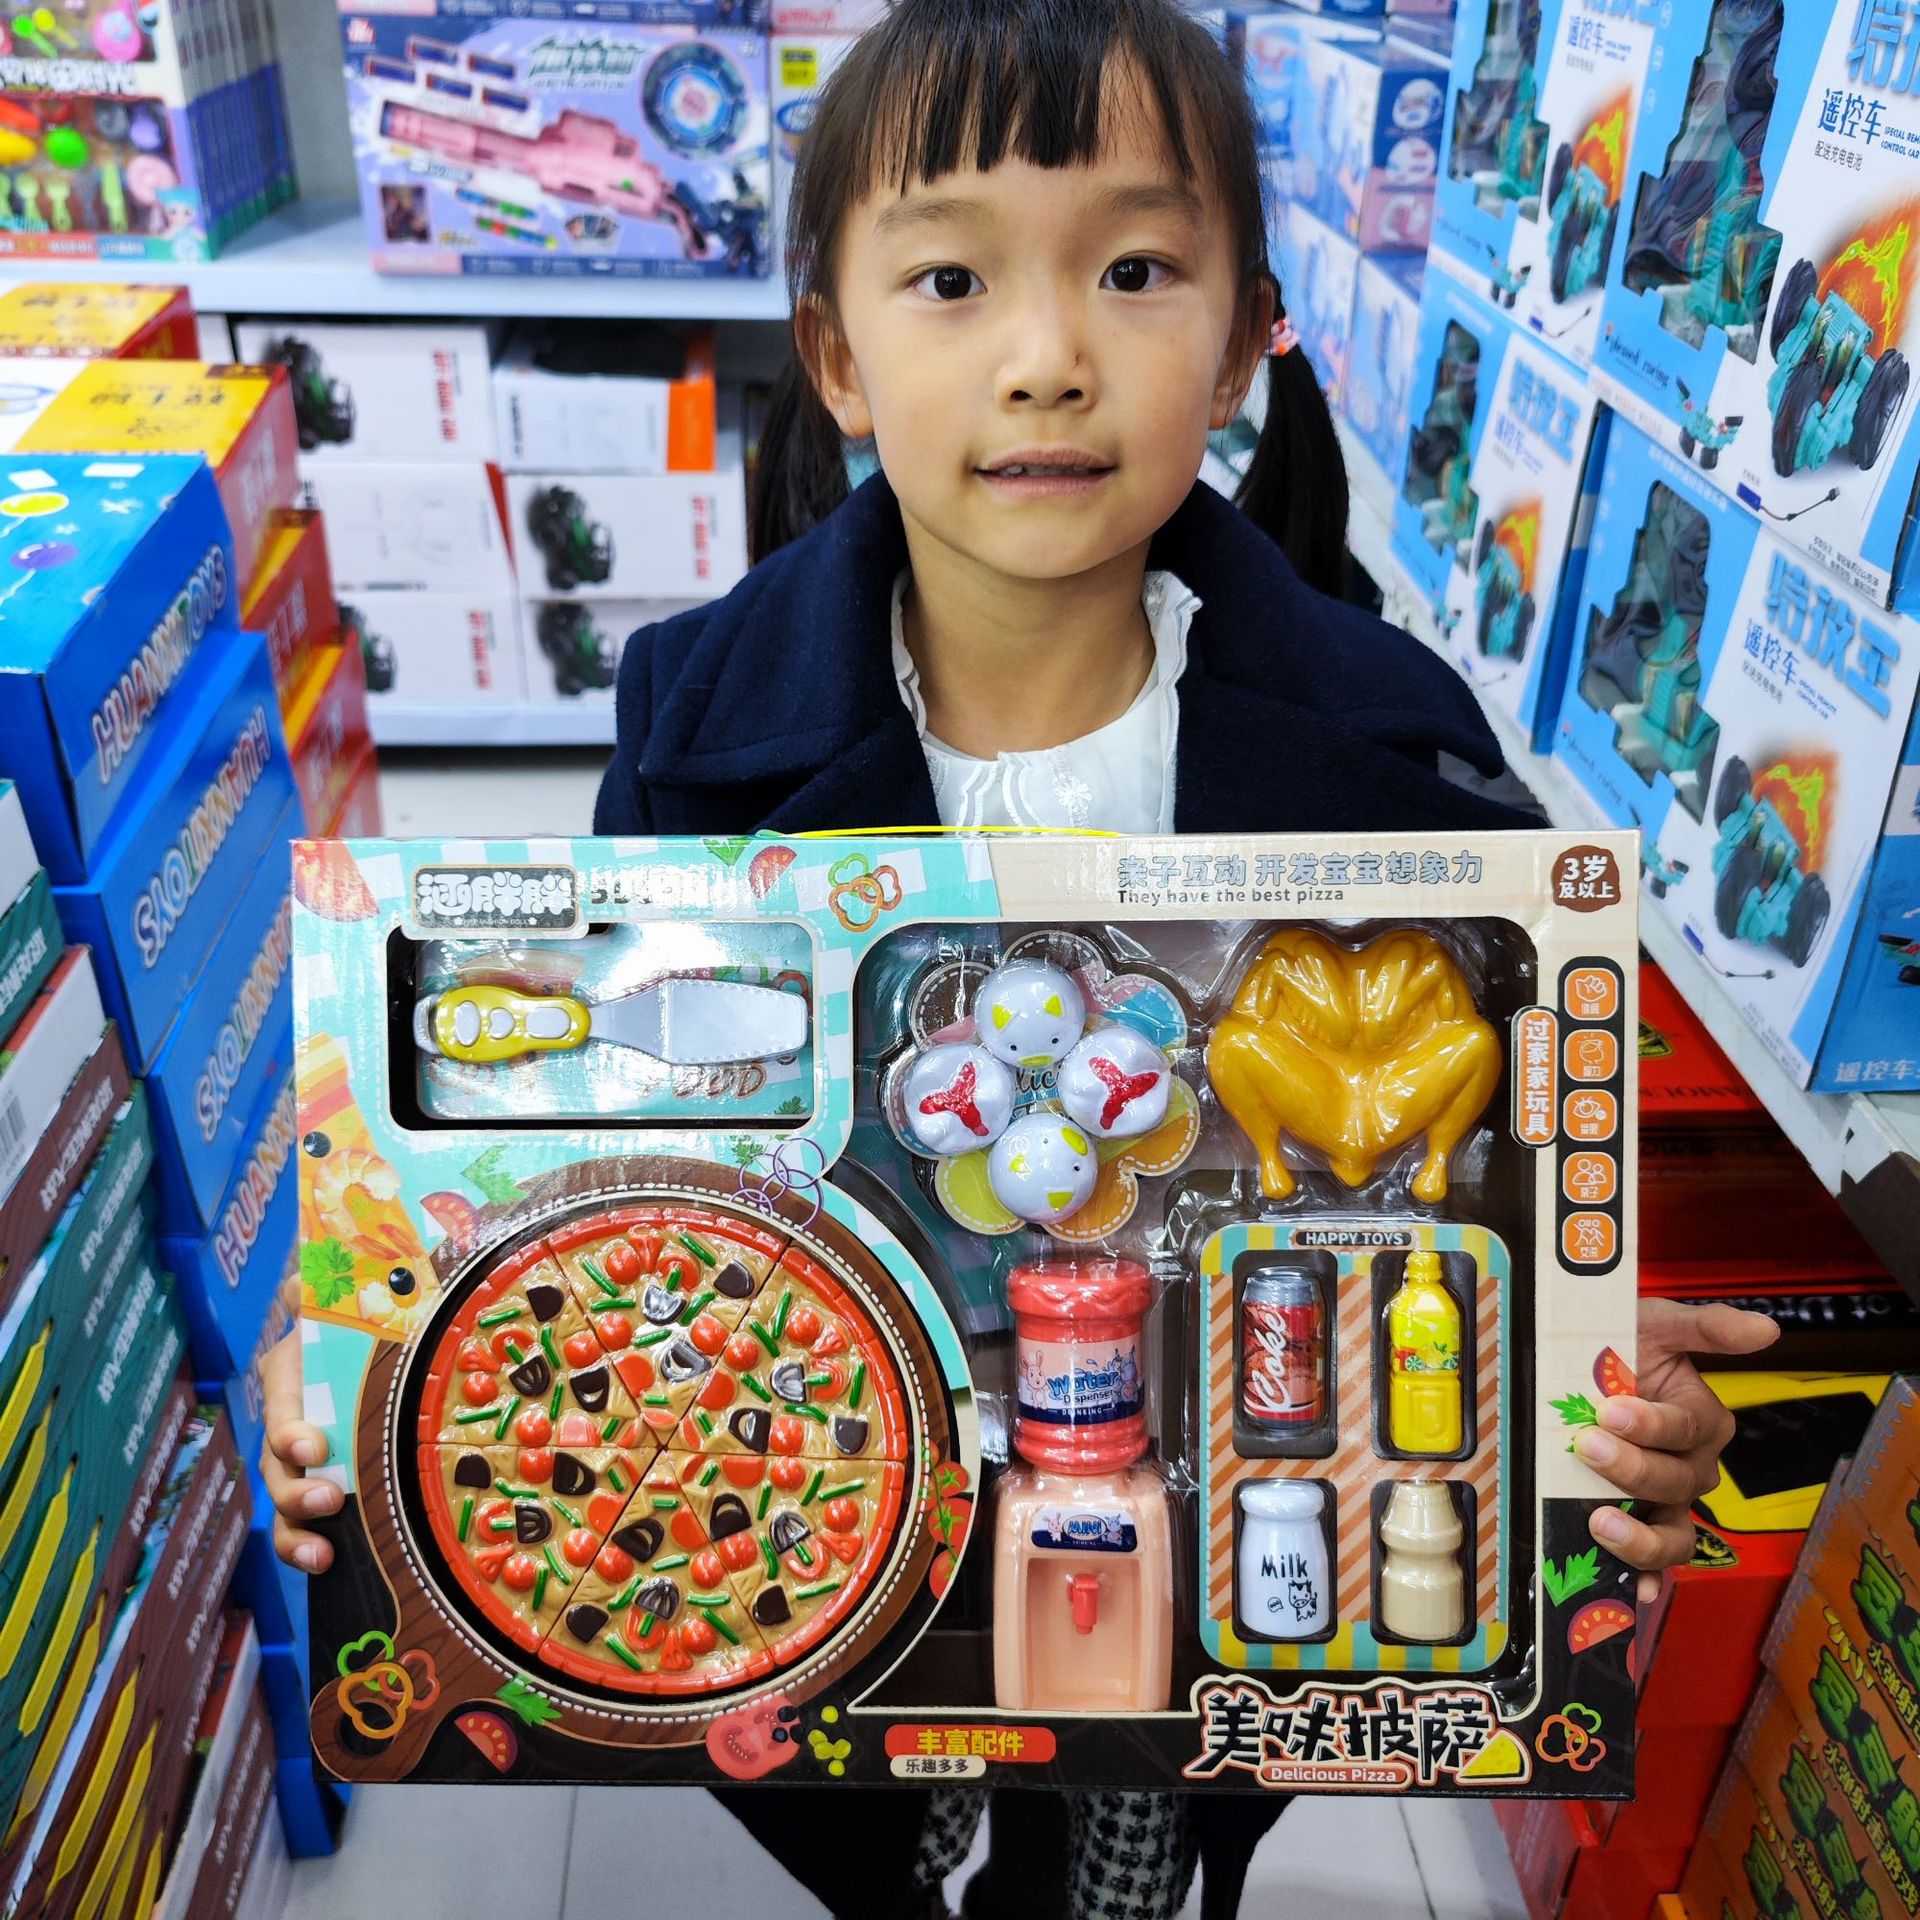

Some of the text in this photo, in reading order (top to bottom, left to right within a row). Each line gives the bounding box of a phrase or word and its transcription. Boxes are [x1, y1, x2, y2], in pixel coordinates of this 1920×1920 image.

[1817, 87, 1887, 145] 遥控车
[1814, 140, 1863, 172] 配送充电电池
[1743, 617, 1801, 687] 遥控车
[1117, 850, 1483, 889] 亲子互动 开发宝宝想象力
[1562, 854, 1608, 883] 3岁
[1118, 887, 1345, 907] They have the best pizza
[1558, 881, 1615, 899] 及以上
[1525, 1018, 1550, 1137] 过家家玩具
[1305, 1231, 1405, 1247] HAPPY TOYS
[1246, 1309, 1292, 1415] Coke
[1046, 1371, 1119, 1397] Water
[1063, 1390, 1114, 1404] Dspenser
[1067, 1519, 1103, 1535] MINI
[1260, 1552, 1309, 1579] Milk
[916, 1728, 1025, 1758] 丰富配件
[1188, 1692, 1492, 1781] 美味披萨
[905, 1757, 970, 1774] 乐趣多多
[1270, 1766, 1397, 1783] Delicious Pizza
